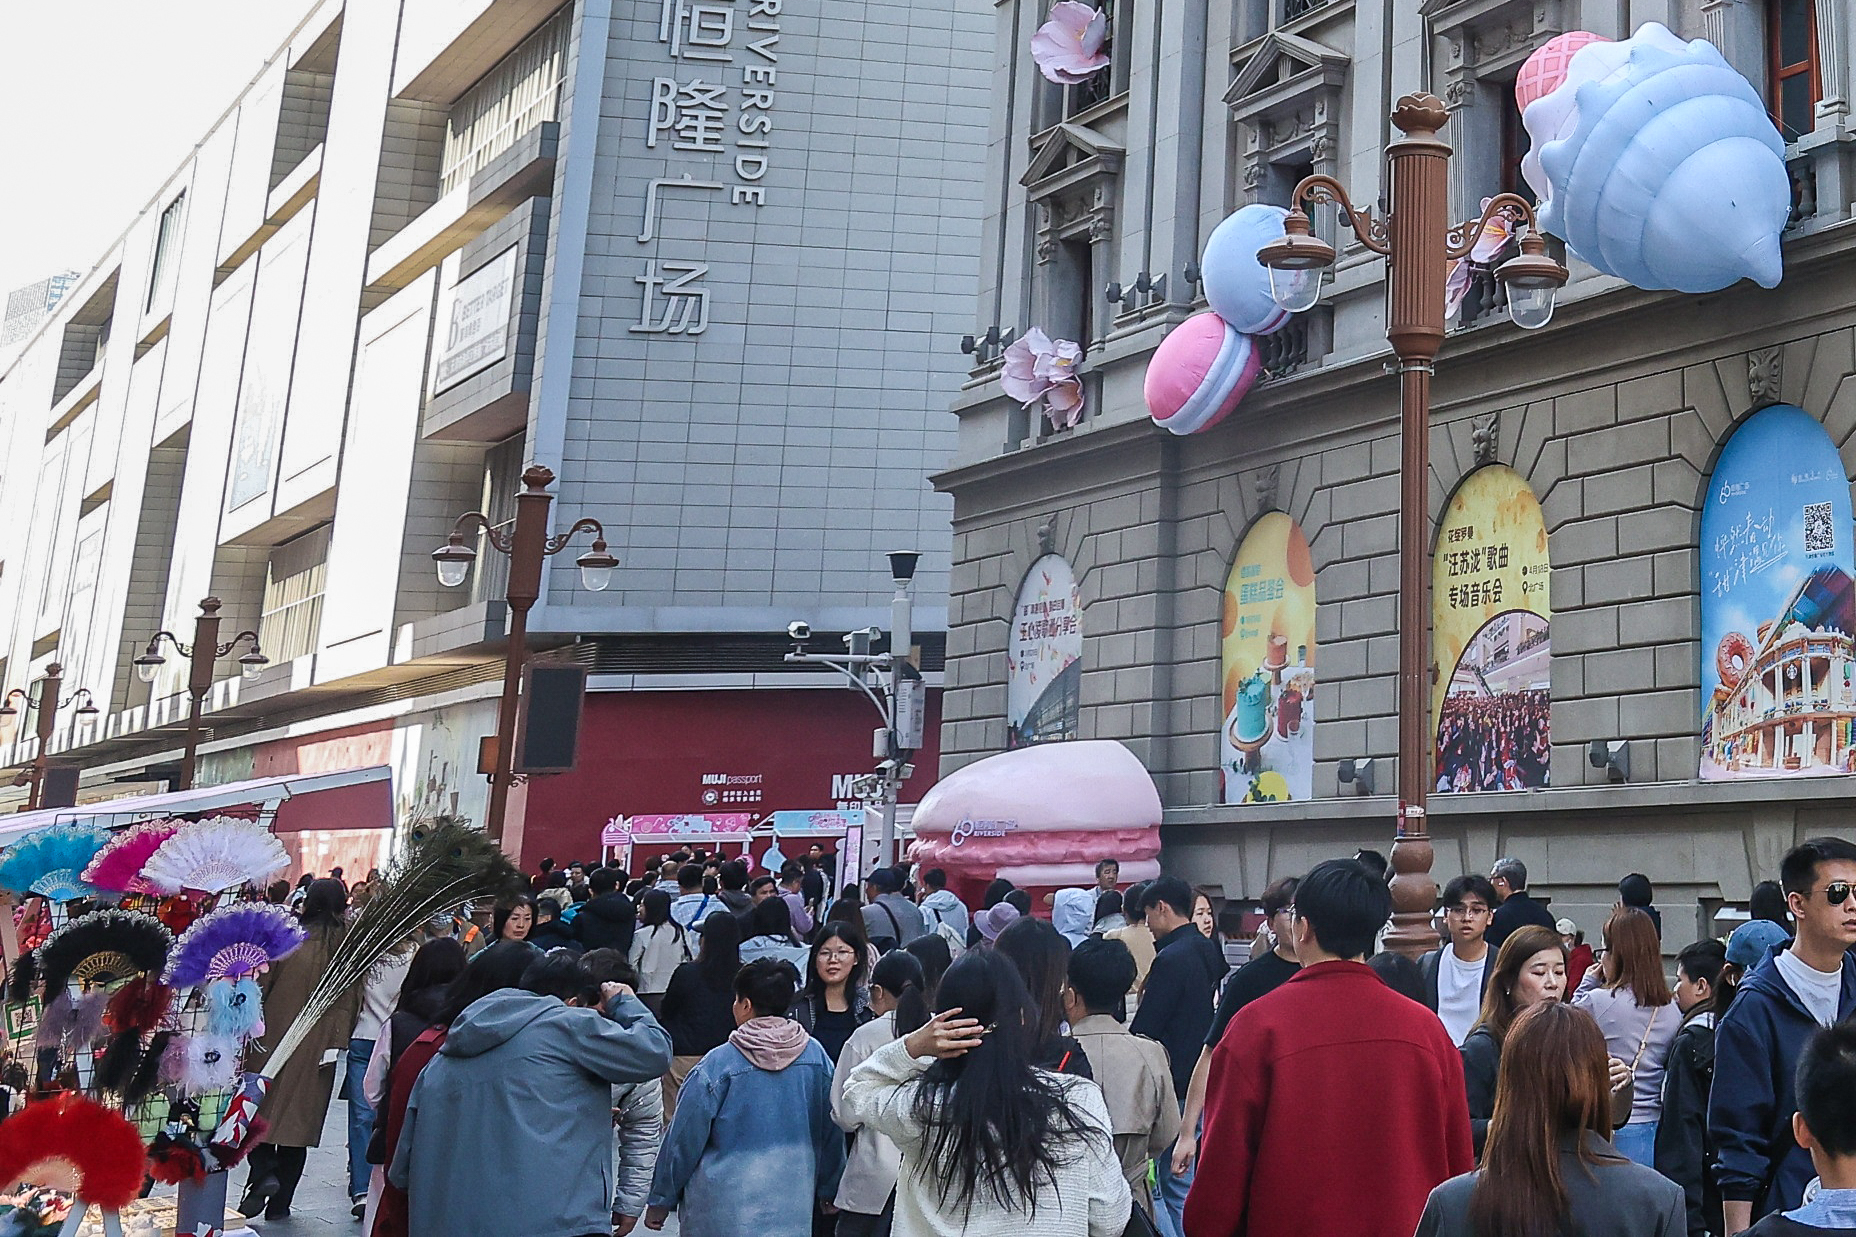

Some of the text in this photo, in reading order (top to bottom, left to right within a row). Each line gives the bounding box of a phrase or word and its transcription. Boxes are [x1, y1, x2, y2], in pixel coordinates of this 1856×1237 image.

[1448, 578, 1503, 610] 专场音乐会
[701, 773, 763, 786] MUJI passport
